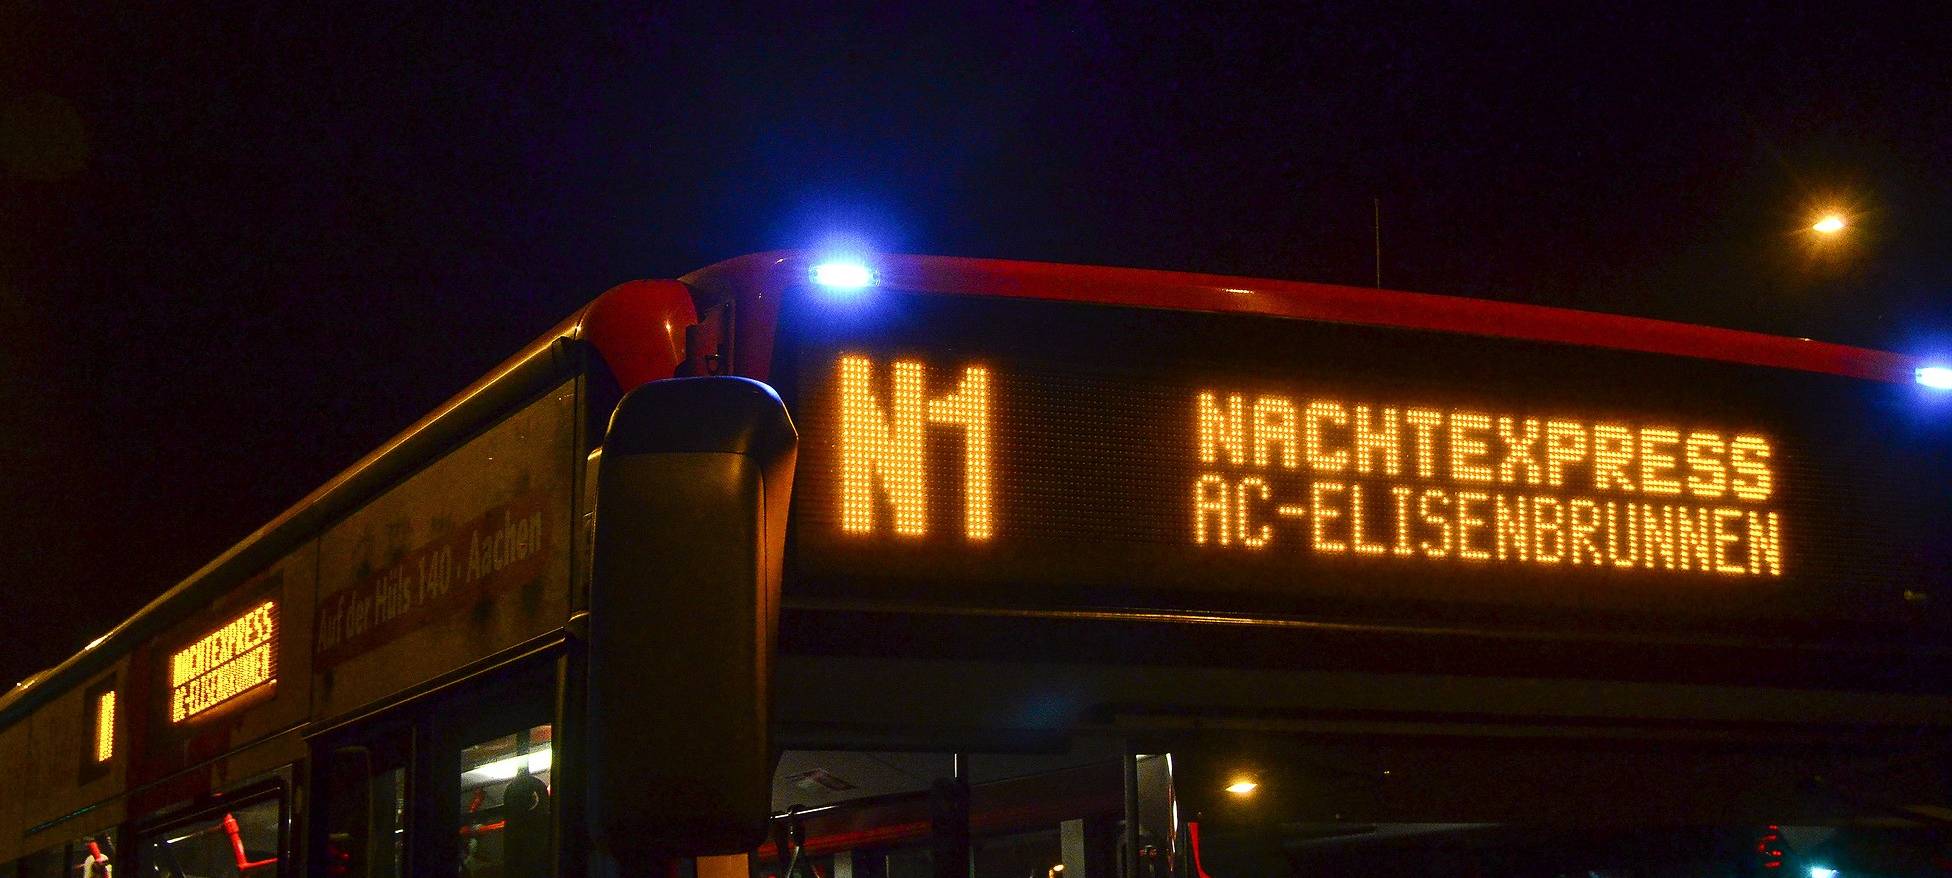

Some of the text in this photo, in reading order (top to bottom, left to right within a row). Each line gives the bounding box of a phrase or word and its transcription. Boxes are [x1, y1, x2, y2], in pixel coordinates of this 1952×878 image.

[837, 354, 997, 541] N1
[1196, 391, 1774, 501] NACHTEXPRESS
[1194, 473, 1783, 576] AC-ELISENBRUNNEN
[317, 509, 543, 654] Auf der Hüls 140 Aachen
[172, 601, 274, 689] NACHTEXPRESS
